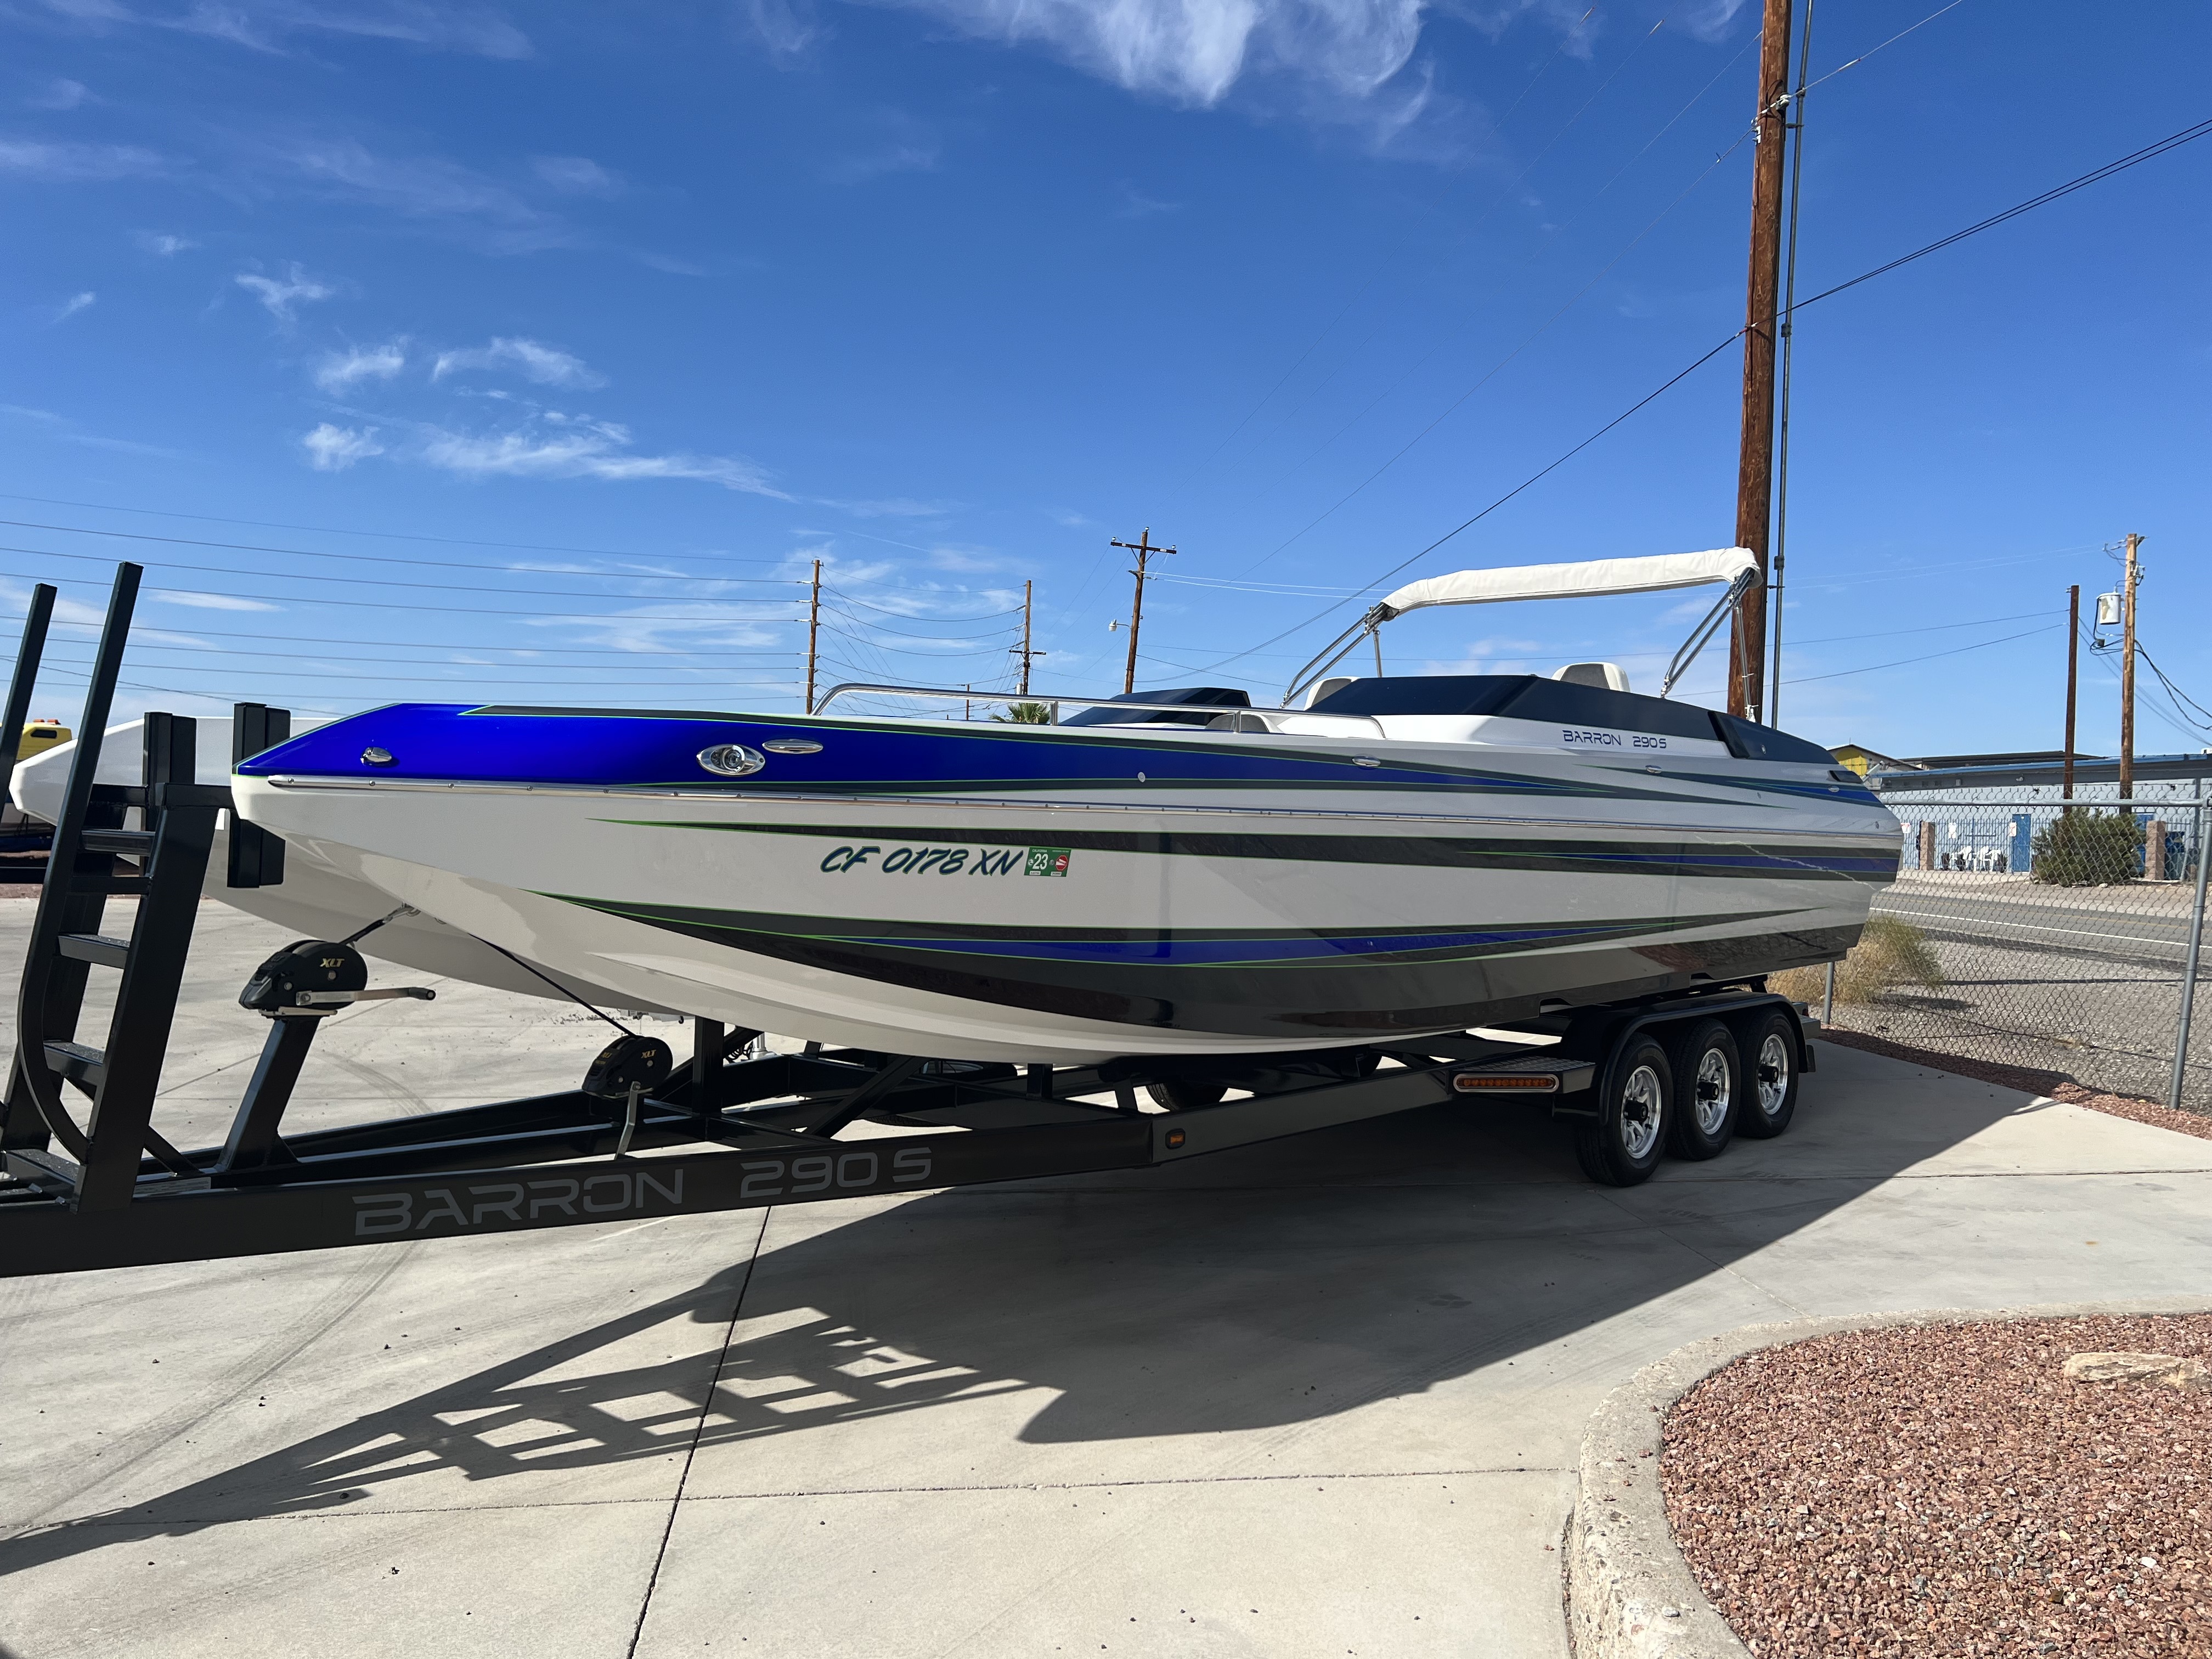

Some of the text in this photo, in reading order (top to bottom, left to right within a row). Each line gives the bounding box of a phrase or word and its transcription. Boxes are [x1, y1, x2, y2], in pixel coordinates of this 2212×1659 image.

[1562, 730, 1622, 746] BARRON
[820, 845, 1024, 876] CF 0178 XN
[1032, 853, 1048, 870] 23
[319, 958, 345, 968] XLT
[641, 1049, 657, 1059] XLT
[351, 1169, 685, 1236] BARRON
